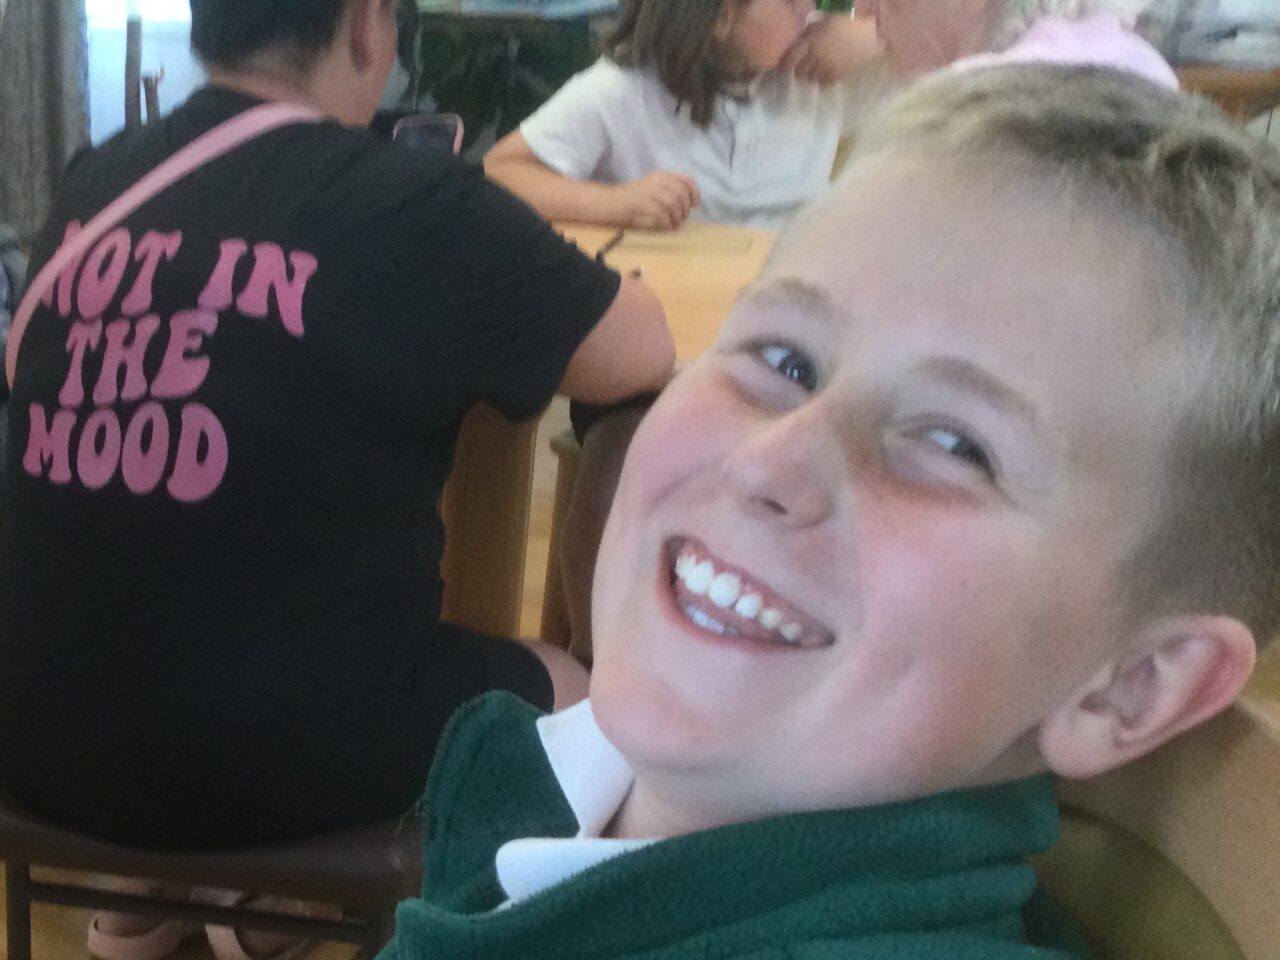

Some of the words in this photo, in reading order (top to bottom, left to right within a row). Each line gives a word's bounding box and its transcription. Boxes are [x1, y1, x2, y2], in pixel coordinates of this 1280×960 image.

[197, 238, 318, 337] IN
[57, 308, 218, 408] THE
[22, 402, 229, 503] MOOD
